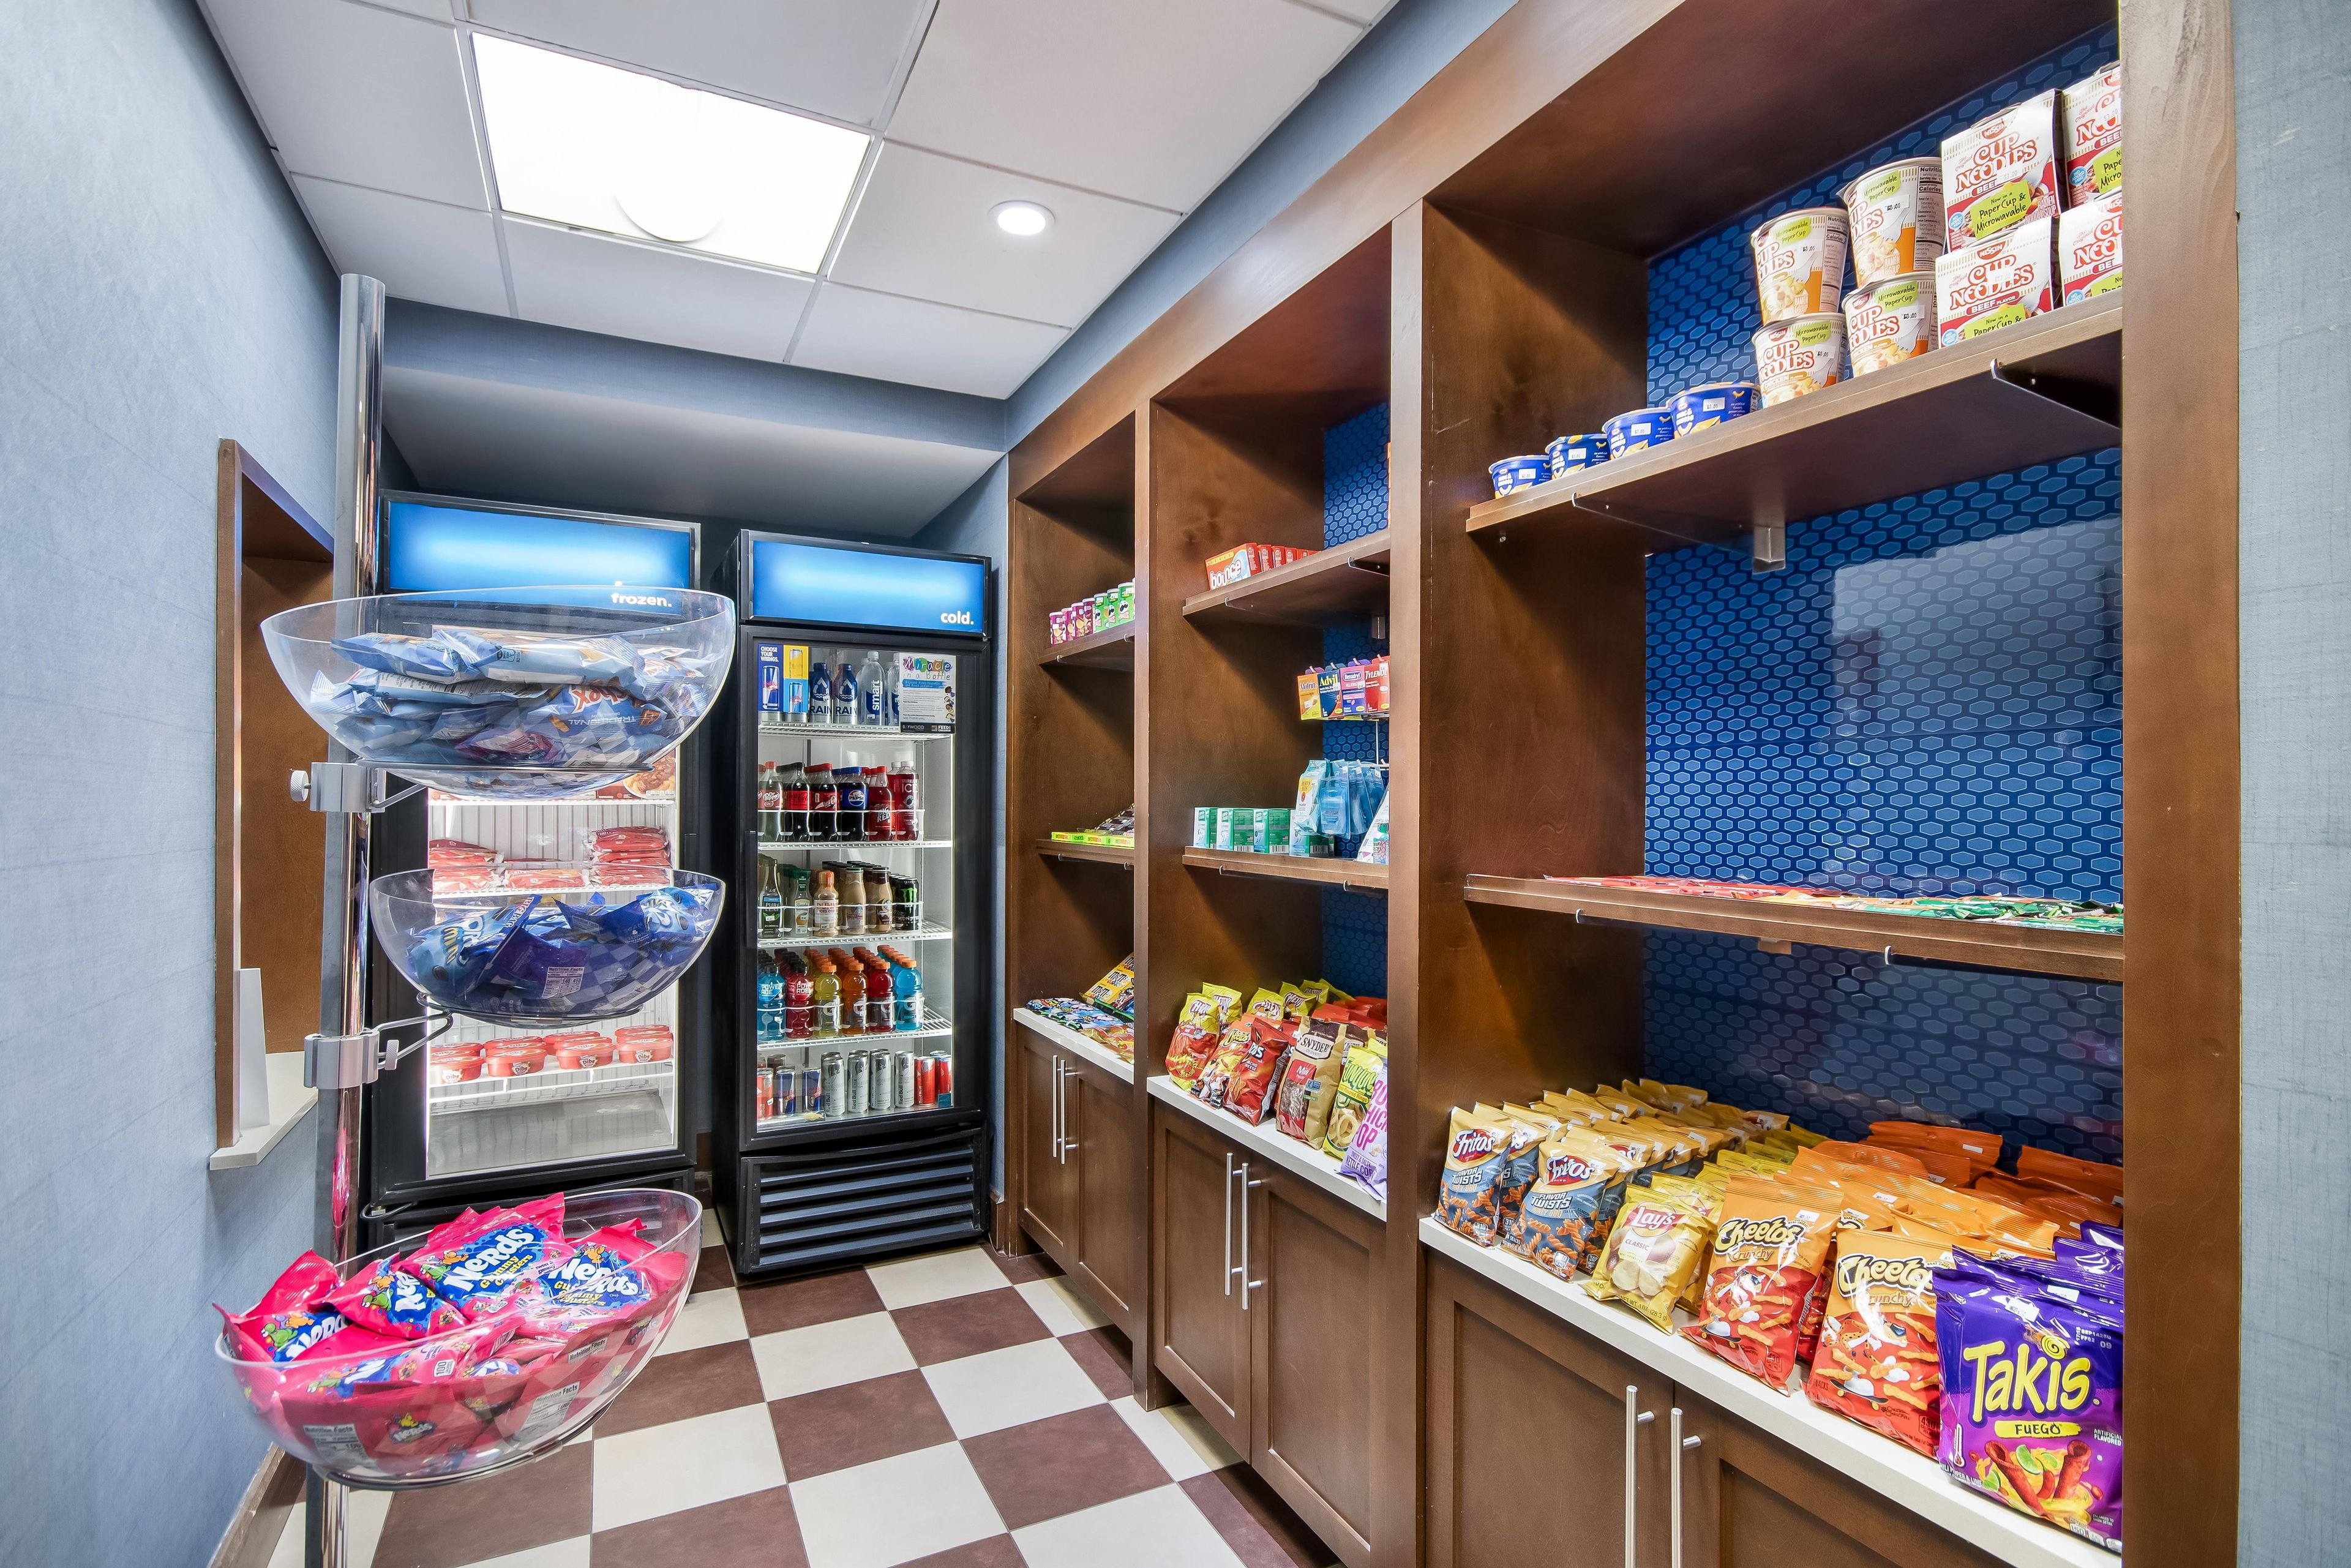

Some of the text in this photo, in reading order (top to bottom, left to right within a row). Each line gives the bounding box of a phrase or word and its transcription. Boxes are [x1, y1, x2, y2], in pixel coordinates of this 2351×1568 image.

[2101, 130, 2121, 146] BEE
[1973, 132, 2019, 166] CUP
[1955, 140, 2038, 193] NOODLES
[2103, 159, 2121, 172] Pape
[1864, 174, 1897, 197] Microwavable
[1869, 186, 1895, 203] Paper Cup
[1991, 196, 2001, 205] Now
[1979, 192, 2027, 219] Paper Cup &
[1976, 202, 2027, 234] Microwavable
[1776, 220, 1808, 239] Microwavable
[1979, 243, 2003, 257] NISSIN
[1878, 285, 1915, 303] Microwavable
[1885, 299, 1901, 307] Paper
[1971, 295, 2016, 313] BEEF FLAVOR
[1850, 306, 1883, 333] CUP
[1796, 324, 1828, 337] Microwavable
[1763, 340, 1799, 364] CUP
[1210, 559, 1242, 590] bounce
[611, 591, 672, 608] frozen.
[940, 611, 974, 625] cold.
[905, 658, 951, 672] Miracle
[1320, 674, 1338, 686] Advil
[1365, 669, 1387, 680] TYLENOL
[877, 812, 890, 822] RED
[1344, 1089, 1367, 1103] Flavored Rings
[1453, 1129, 1495, 1158] Fritos
[1547, 1155, 1595, 1180] Fritos
[1452, 1170, 1483, 1185] TWISTS
[1531, 1195, 1573, 1209] TWISTS
[1631, 1206, 1676, 1231] Lay's
[1714, 1215, 1807, 1255] Cheetos
[1625, 1239, 1650, 1251] CLASSIC
[1730, 1248, 1774, 1262] Crunchy
[480, 1255, 519, 1289] Gummy
[495, 1254, 533, 1287] Clusters
[1868, 1292, 1913, 1307] runchy
[569, 1339, 606, 1360] Nutrition Facts
[1768, 1352, 1780, 1364] 430
[435, 1361, 447, 1376] 100
[1963, 1336, 2091, 1422] Takis
[563, 1384, 579, 1395] Facts
[1921, 1416, 1937, 1428] 430
[2015, 1423, 2061, 1435] FUEGO
[2094, 1428, 2123, 1440] ARTIFICIAL
[2094, 1434, 2122, 1446] FLAVORED
[1970, 1476, 1983, 1485] LIME
